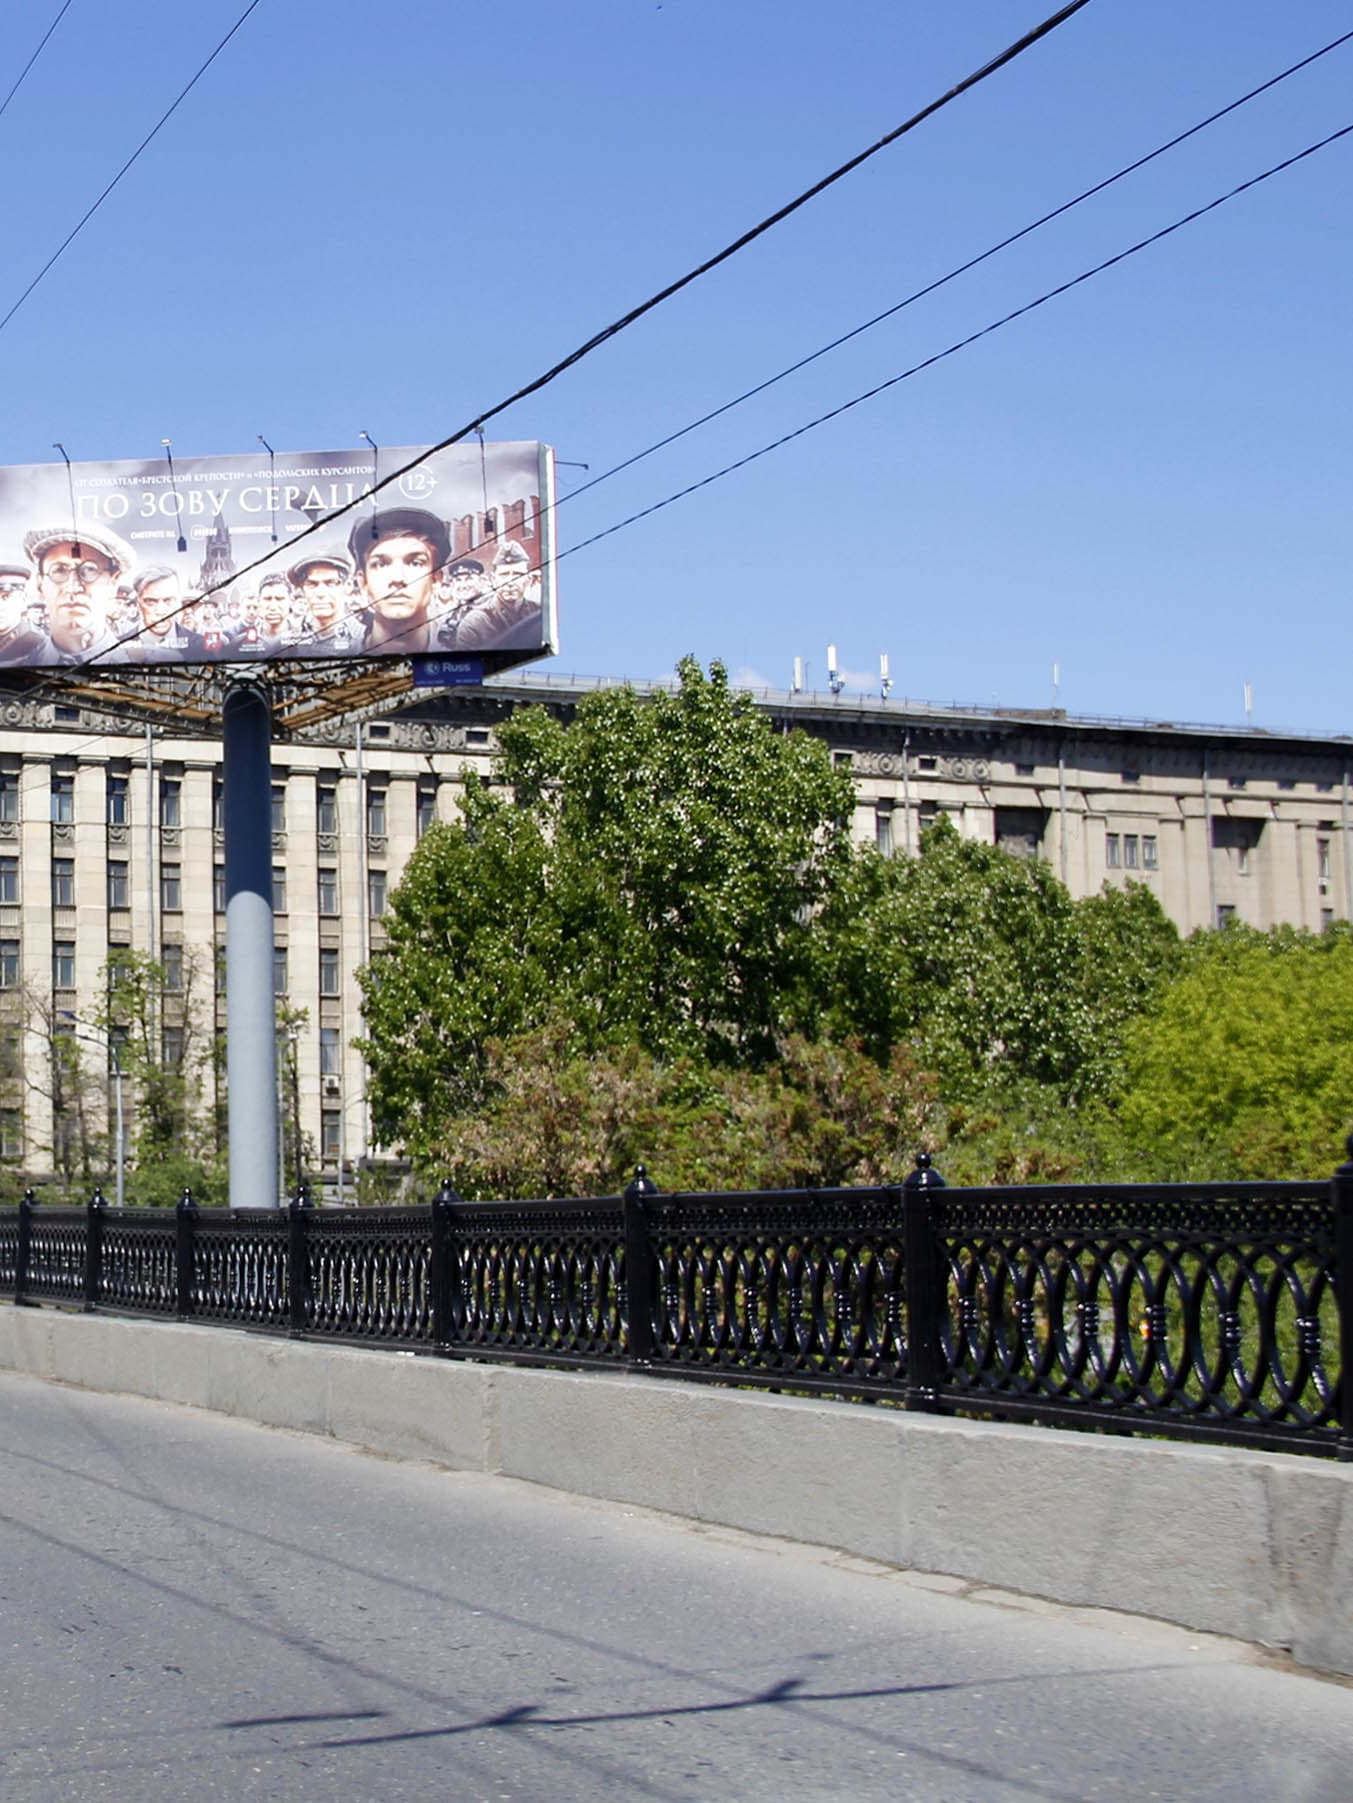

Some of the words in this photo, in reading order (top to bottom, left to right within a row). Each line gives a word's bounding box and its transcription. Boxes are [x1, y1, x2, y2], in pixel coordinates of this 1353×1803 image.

[405, 473, 440, 492] 12+
[77, 492, 130, 520] ПО
[139, 488, 232, 519] ЗОВУ
[239, 481, 381, 513] СЕРДЦА
[442, 662, 471, 673] Russ
